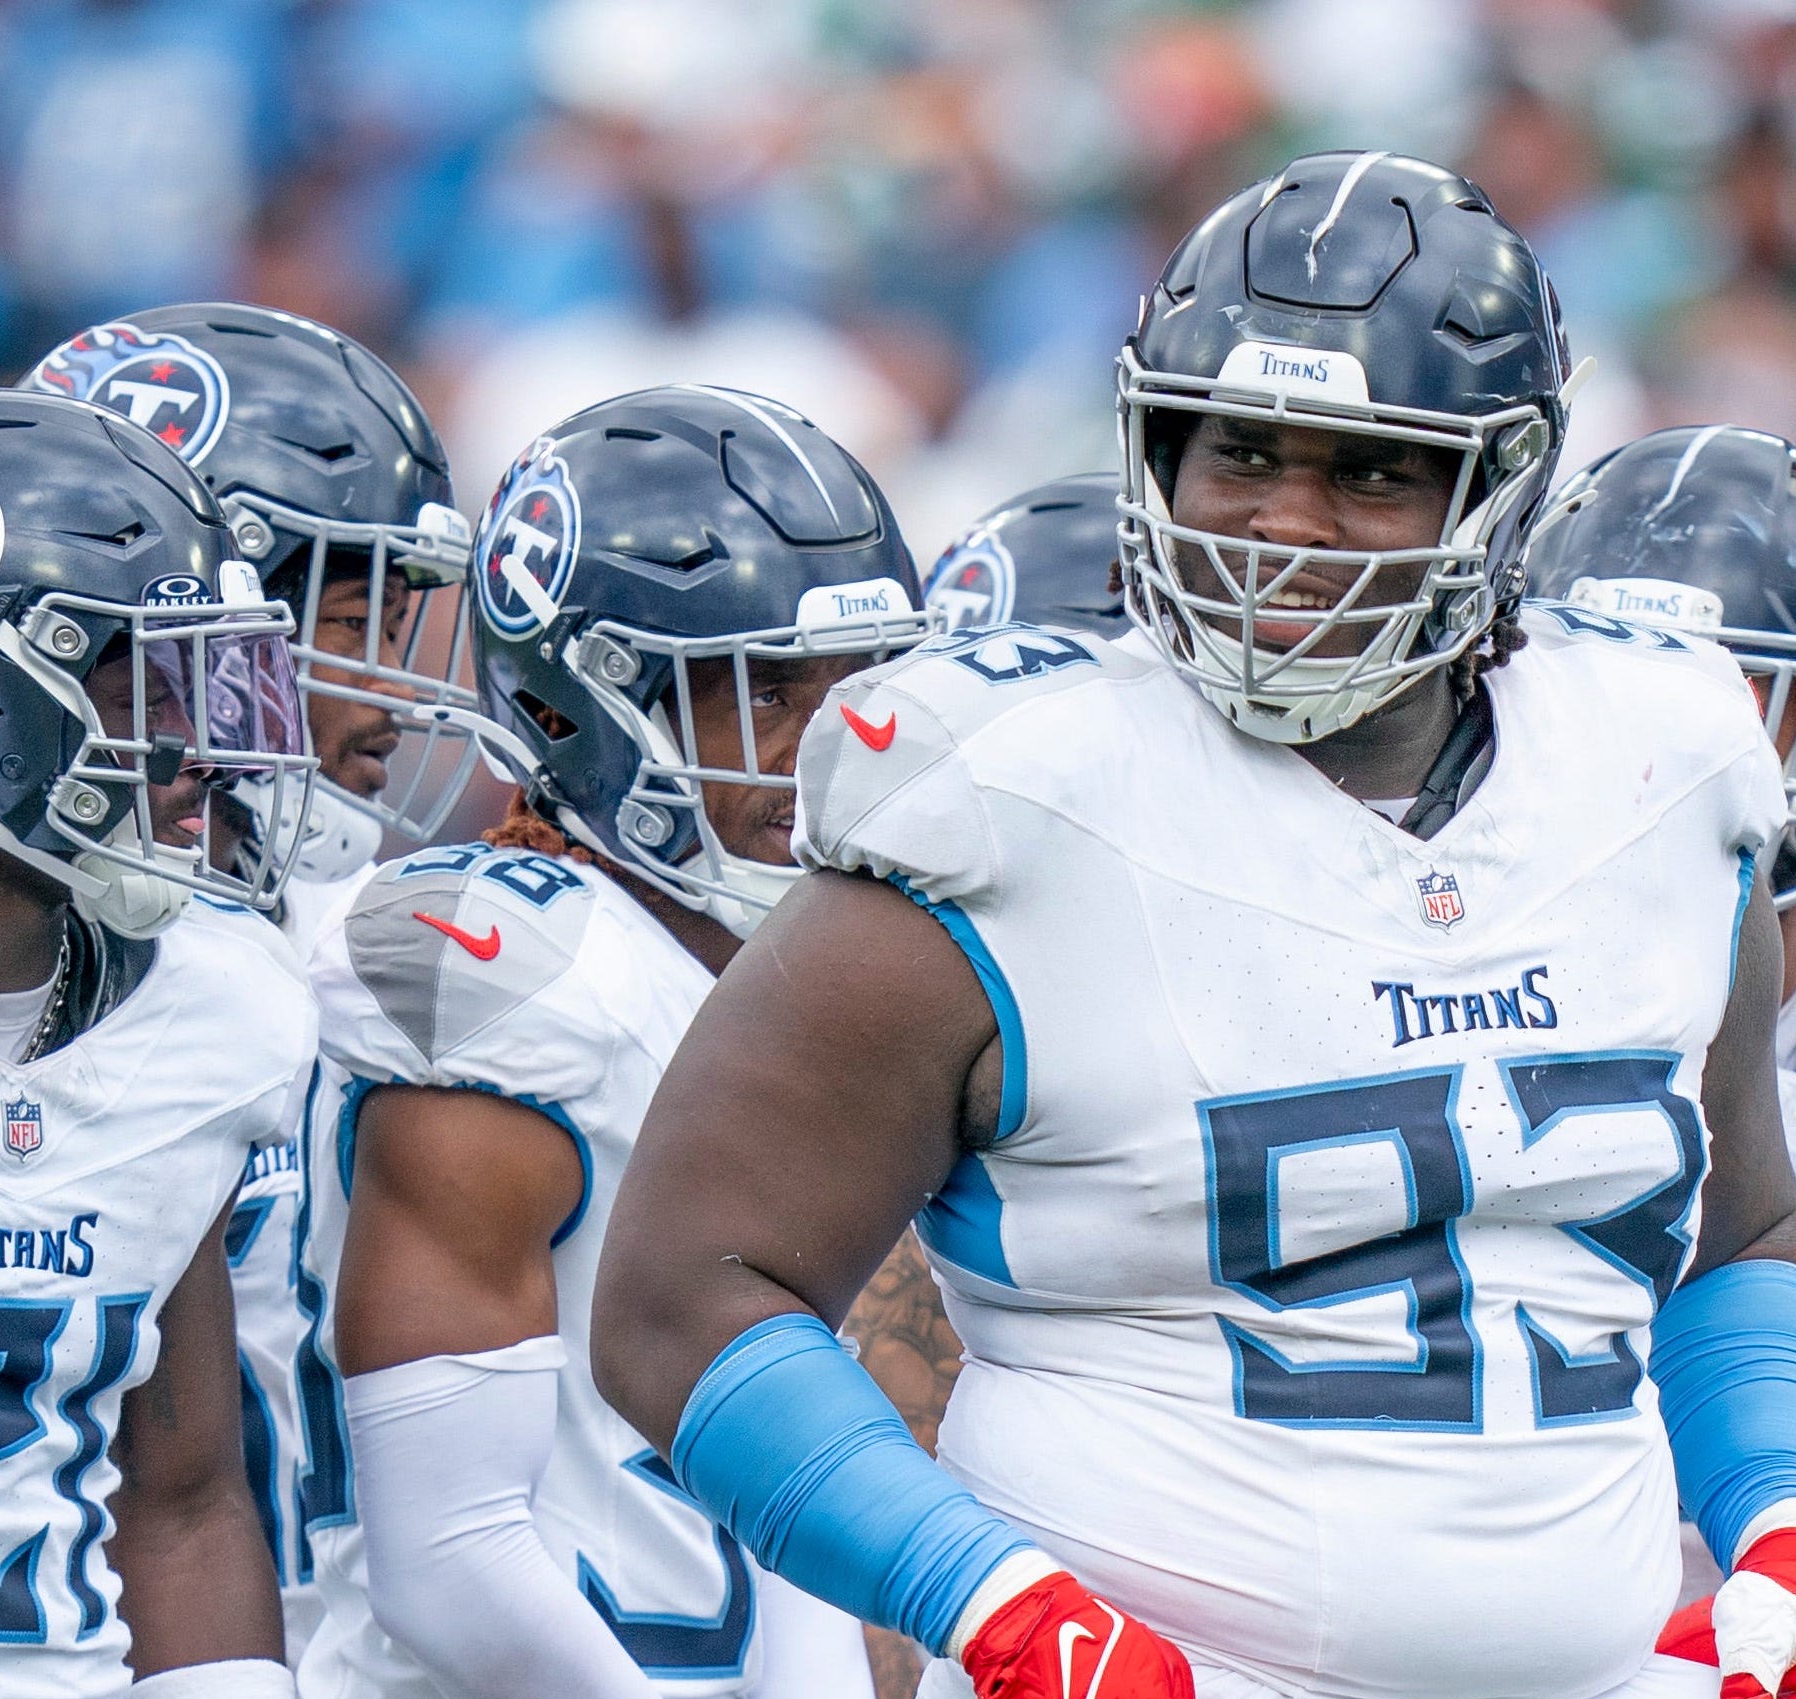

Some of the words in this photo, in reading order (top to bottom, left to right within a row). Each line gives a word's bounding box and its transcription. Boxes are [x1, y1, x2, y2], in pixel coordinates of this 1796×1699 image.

[1260, 351, 1329, 382] TITANS
[147, 596, 210, 607] OAKLEY
[832, 589, 888, 617] TITANS
[1614, 588, 1682, 617] TITANS
[1425, 892, 1462, 924] NFL
[1372, 965, 1558, 1048] TITANS
[10, 1121, 40, 1150] NFL
[1196, 1049, 1708, 1434] 93
